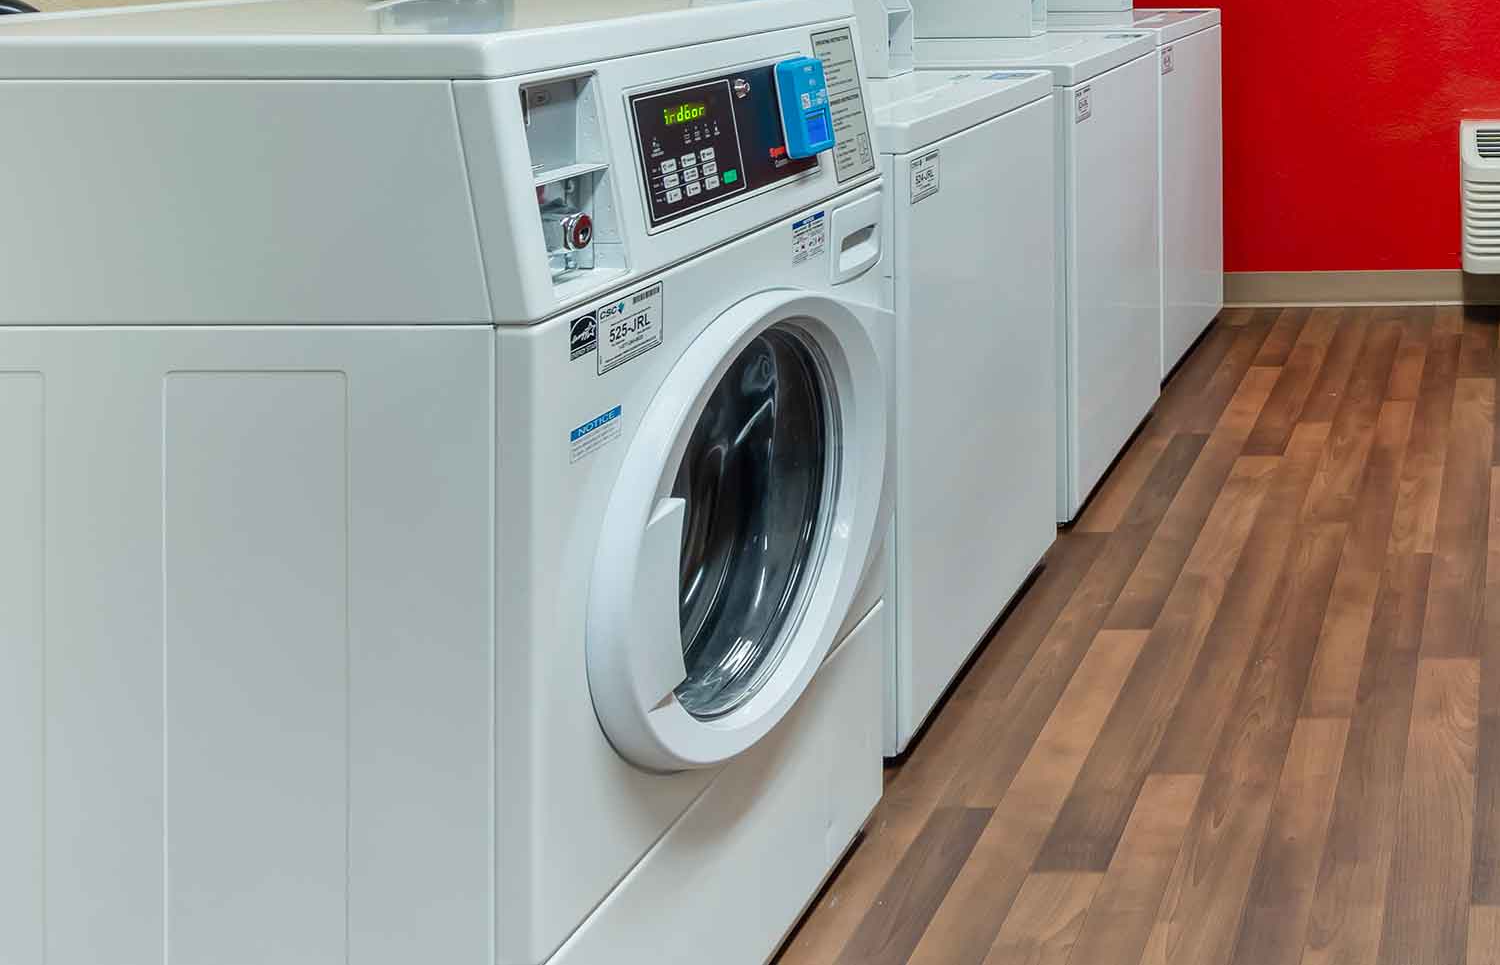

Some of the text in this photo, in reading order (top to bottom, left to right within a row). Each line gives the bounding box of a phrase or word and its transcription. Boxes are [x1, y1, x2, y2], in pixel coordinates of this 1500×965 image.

[600, 305, 618, 320] CSC
[609, 313, 651, 343] 525-JRL
[578, 409, 615, 437] NOTICE
